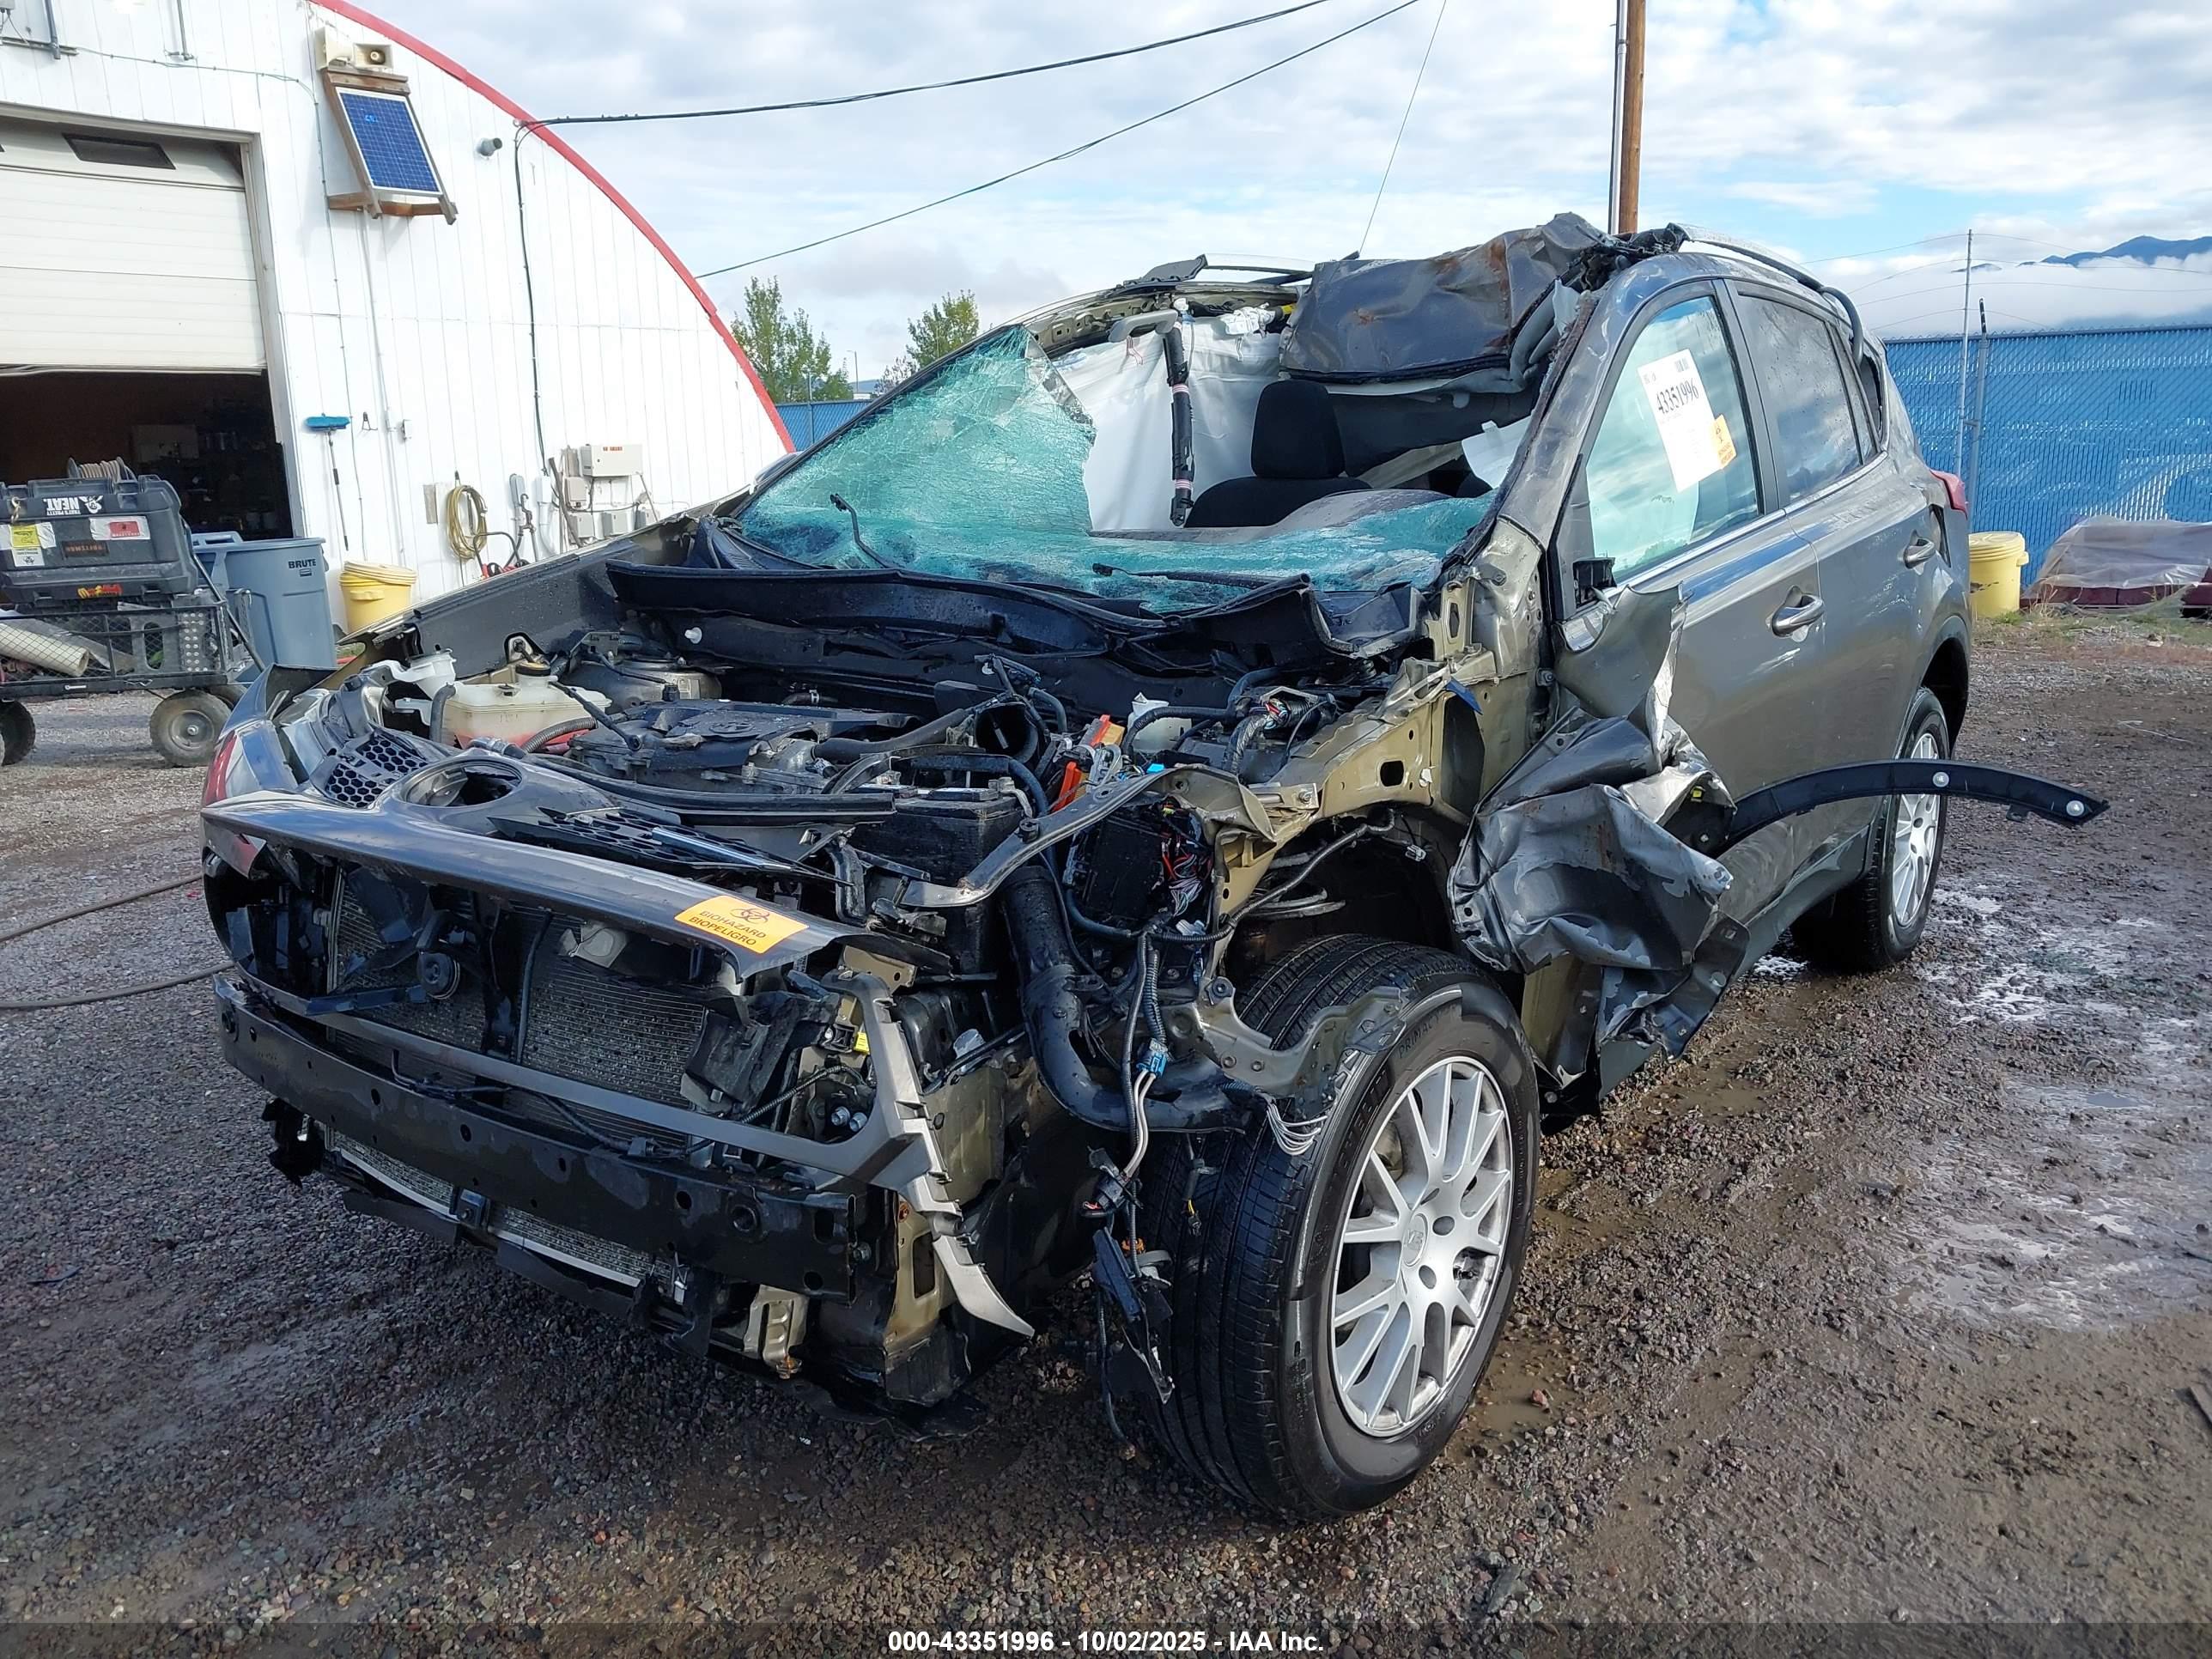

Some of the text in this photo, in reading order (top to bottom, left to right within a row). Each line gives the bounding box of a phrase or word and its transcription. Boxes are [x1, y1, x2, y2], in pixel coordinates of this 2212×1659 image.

[1656, 377, 1699, 414] 43351996
[43, 497, 80, 510] NEAT.
[288, 558, 317, 568] BRUTE
[688, 916, 757, 945] BIOPELIGRO
[699, 910, 767, 939] BIOHAZARD
[1398, 1013, 1441, 1058] PRIMACY
